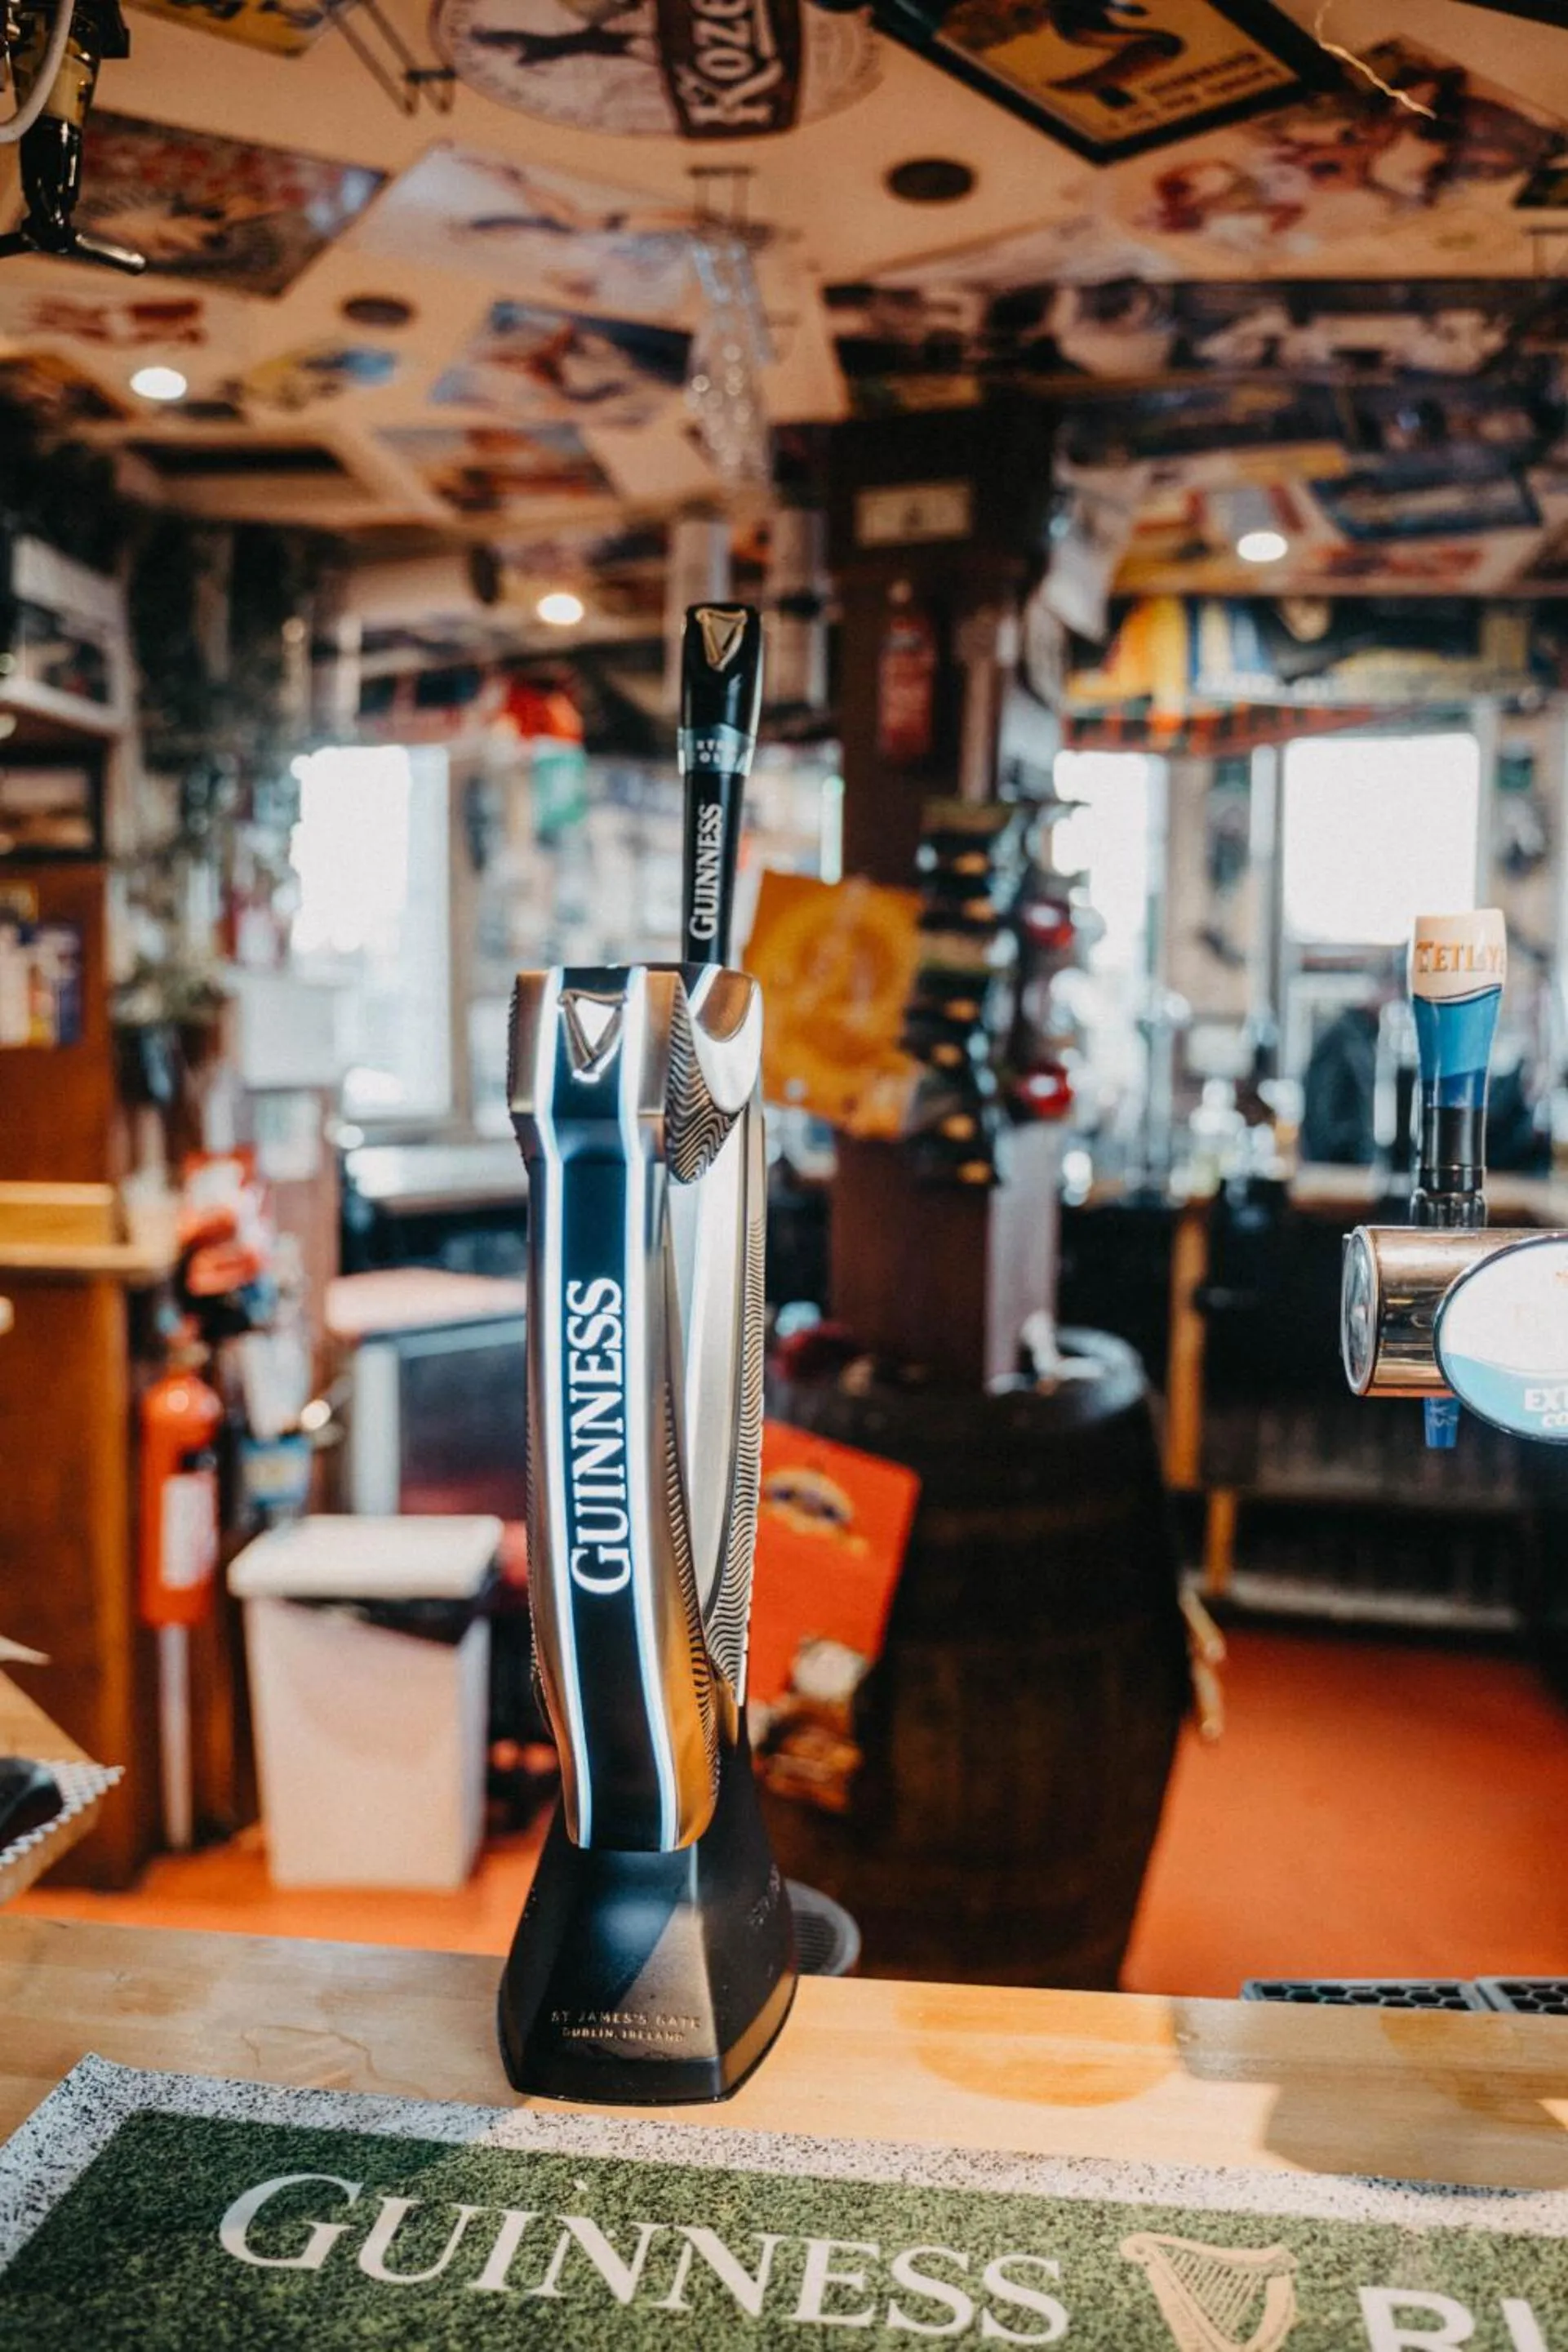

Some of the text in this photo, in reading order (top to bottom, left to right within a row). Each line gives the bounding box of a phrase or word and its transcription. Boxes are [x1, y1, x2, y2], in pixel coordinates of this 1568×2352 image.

[689, 803, 723, 940] GUINNESS
[1416, 940, 1502, 973] TETLY
[566, 1278, 631, 1594] GUINNESS
[655, 2014, 702, 2030] GATE
[219, 2173, 1070, 2344] GUINNESS
